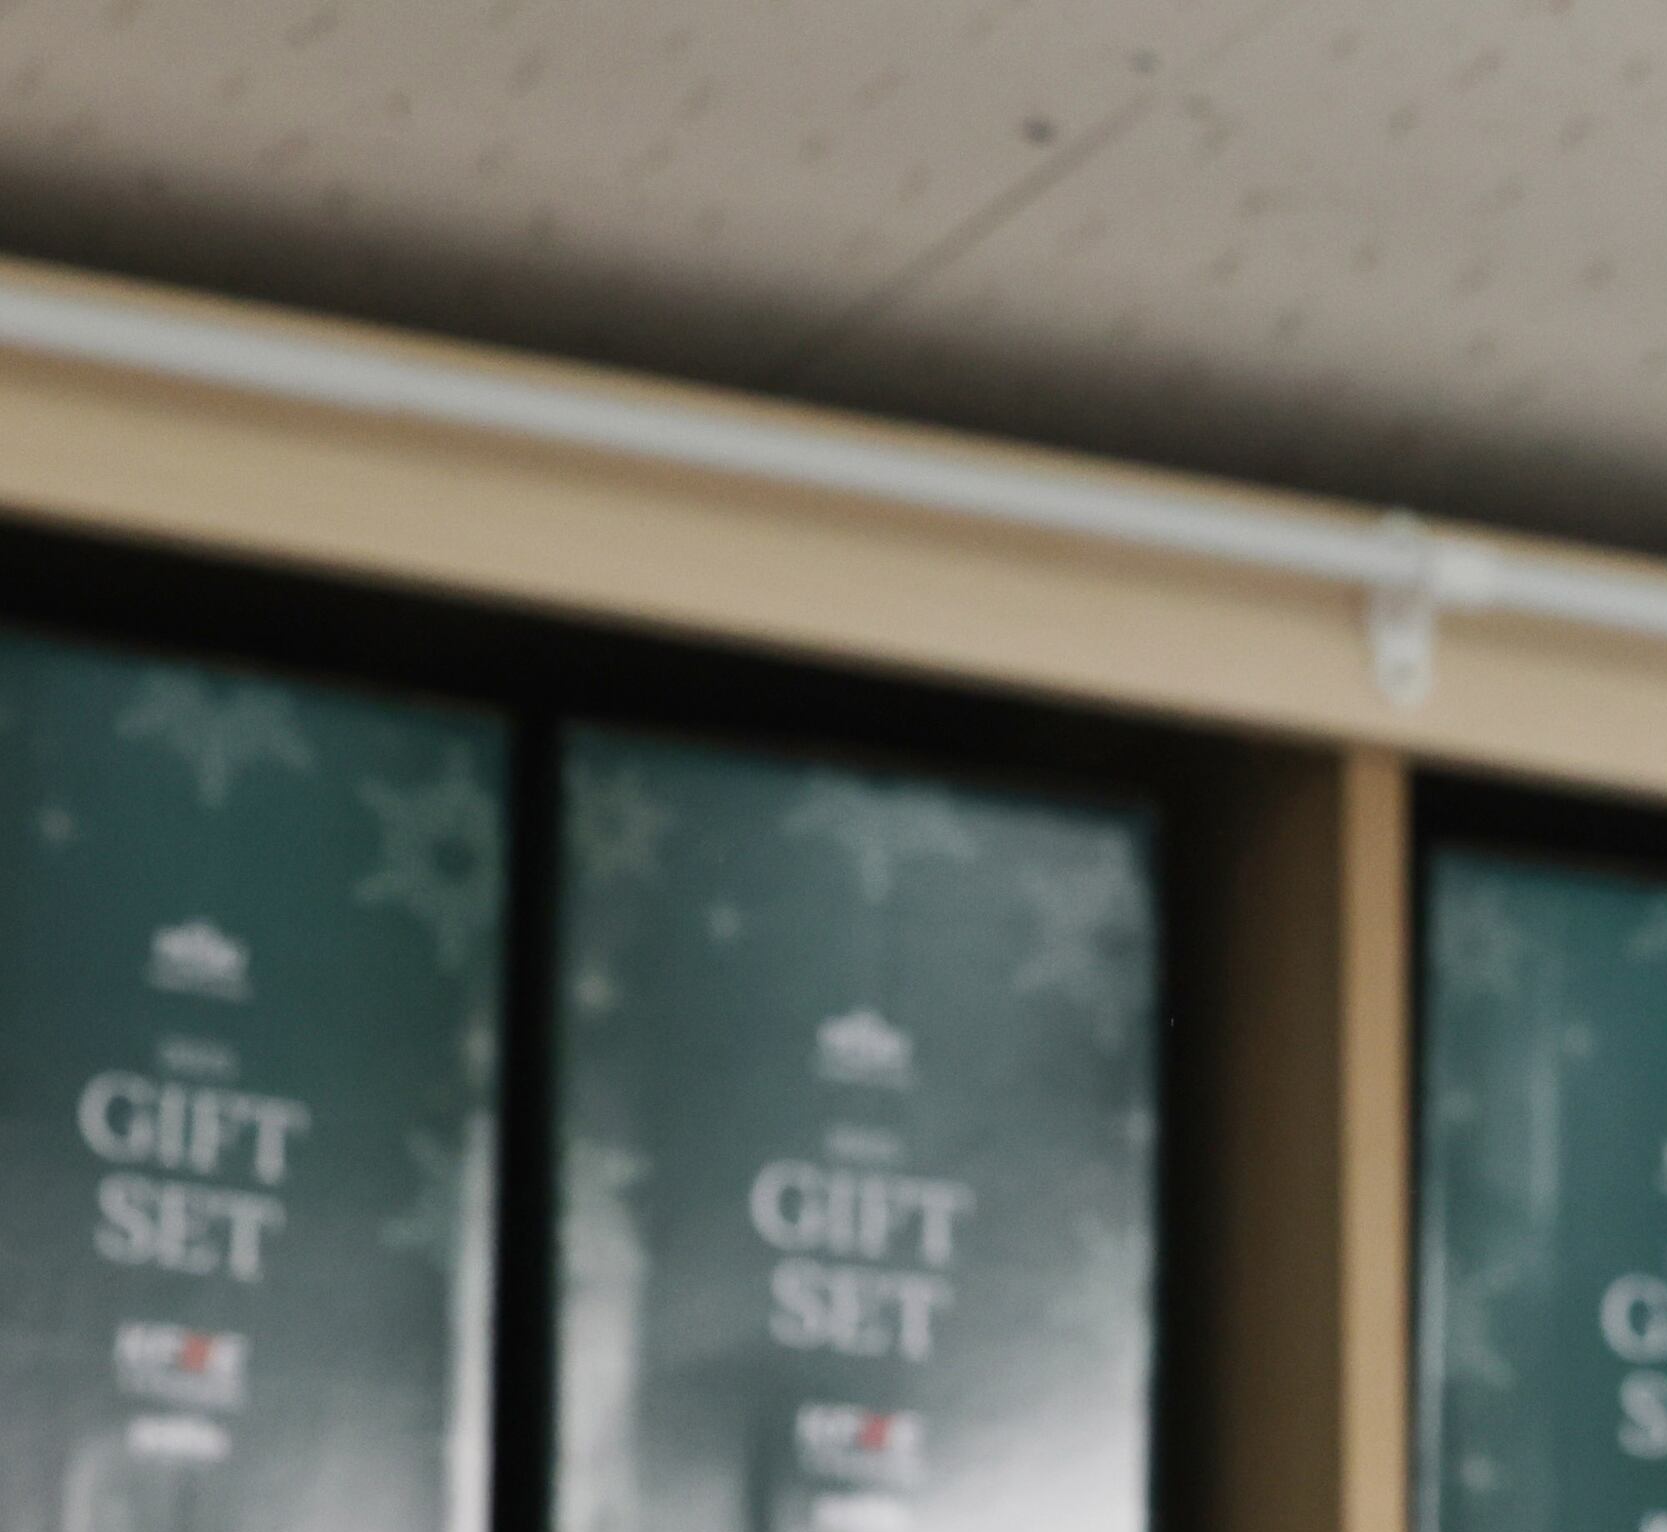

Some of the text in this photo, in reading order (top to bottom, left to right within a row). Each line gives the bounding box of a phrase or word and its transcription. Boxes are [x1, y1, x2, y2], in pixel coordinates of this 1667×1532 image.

[78, 1070, 311, 1185] GIFT
[93, 1172, 287, 1283] SET
[748, 1157, 977, 1266] GIFT
[768, 1256, 954, 1363] SET
